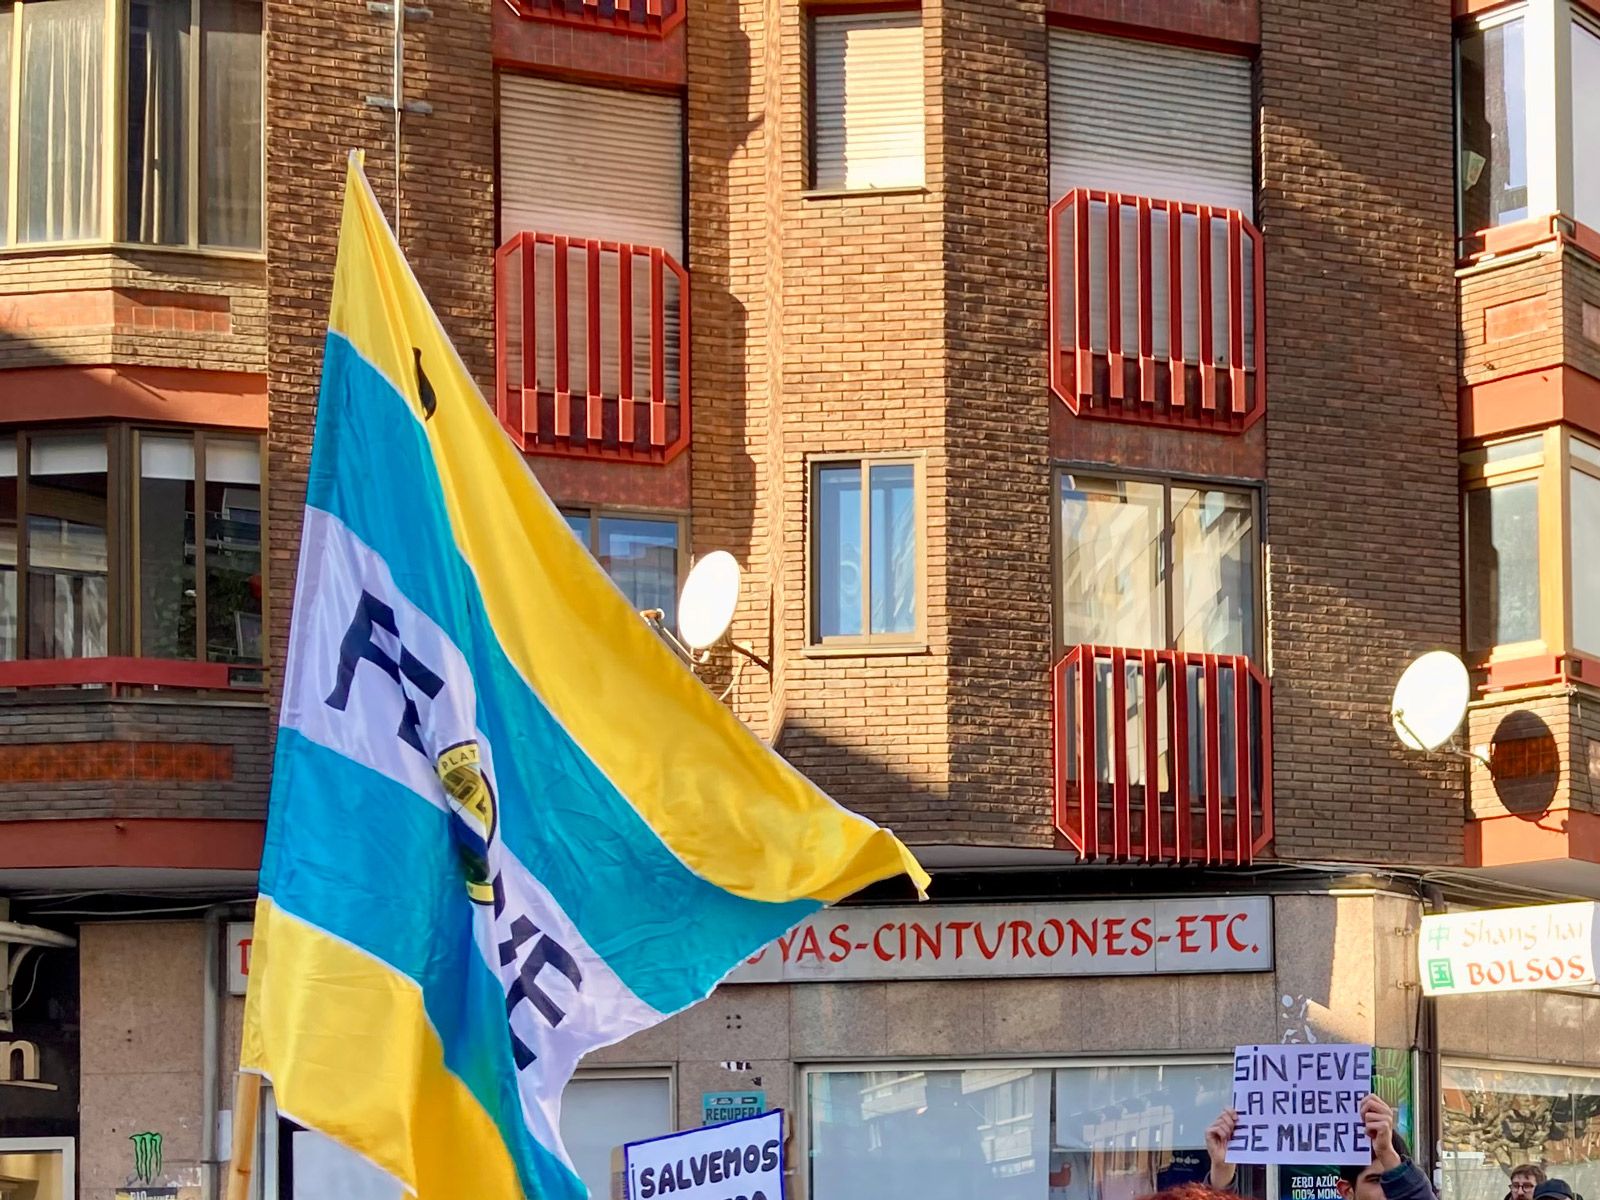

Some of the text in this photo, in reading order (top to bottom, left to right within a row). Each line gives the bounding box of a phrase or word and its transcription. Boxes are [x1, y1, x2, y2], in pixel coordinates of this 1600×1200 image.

[1466, 954, 1586, 986] BOLSOS
[1298, 1052, 1370, 1081] FEVE
[1234, 1091, 1264, 1116] LA
[1228, 1122, 1371, 1153] SE MUERE
[1291, 1176, 1314, 1188] ZERO
[1292, 1188, 1315, 1200] 100%
